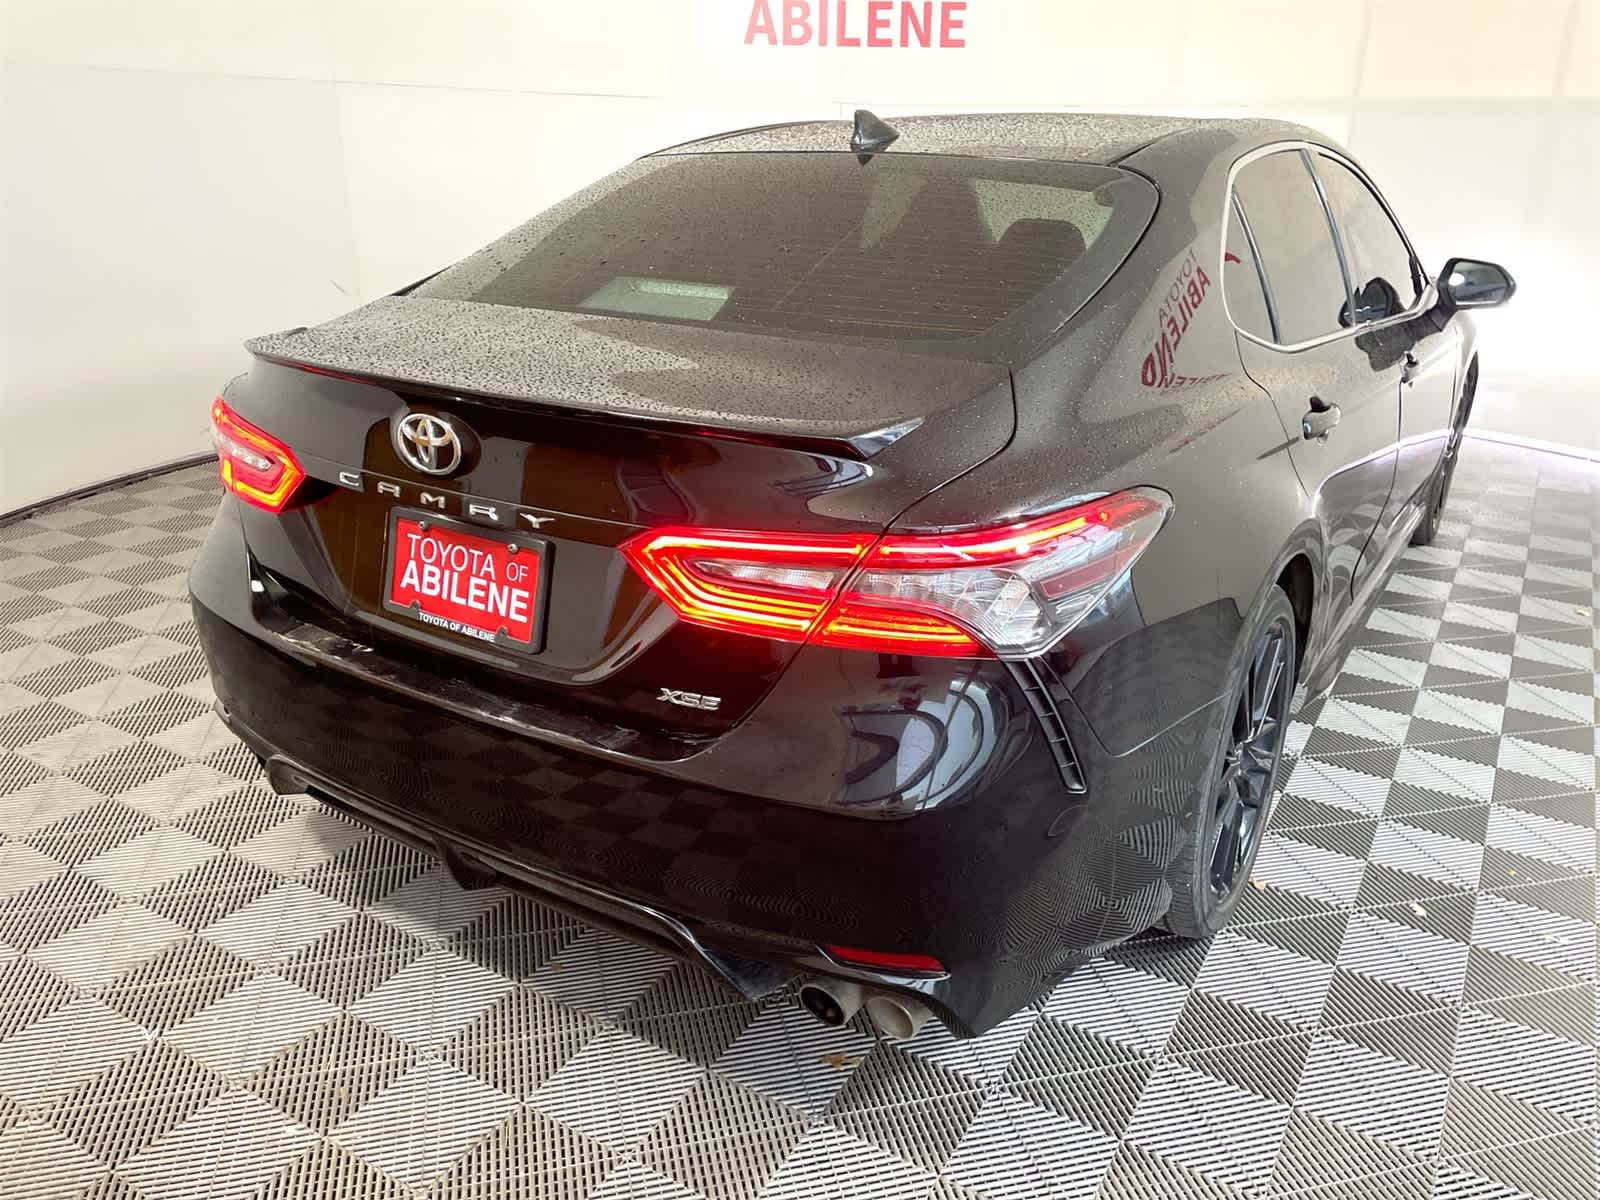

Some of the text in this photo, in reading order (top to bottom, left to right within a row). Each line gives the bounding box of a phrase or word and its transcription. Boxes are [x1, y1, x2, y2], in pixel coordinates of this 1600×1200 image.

[744, 0, 967, 48] ABILENE
[339, 471, 555, 528] CAMRY
[407, 533, 529, 583] TOYOTA OF
[400, 560, 530, 623] ABILENE
[419, 612, 496, 642] TOYOTA OF ABILENE
[656, 687, 722, 711] XSE
